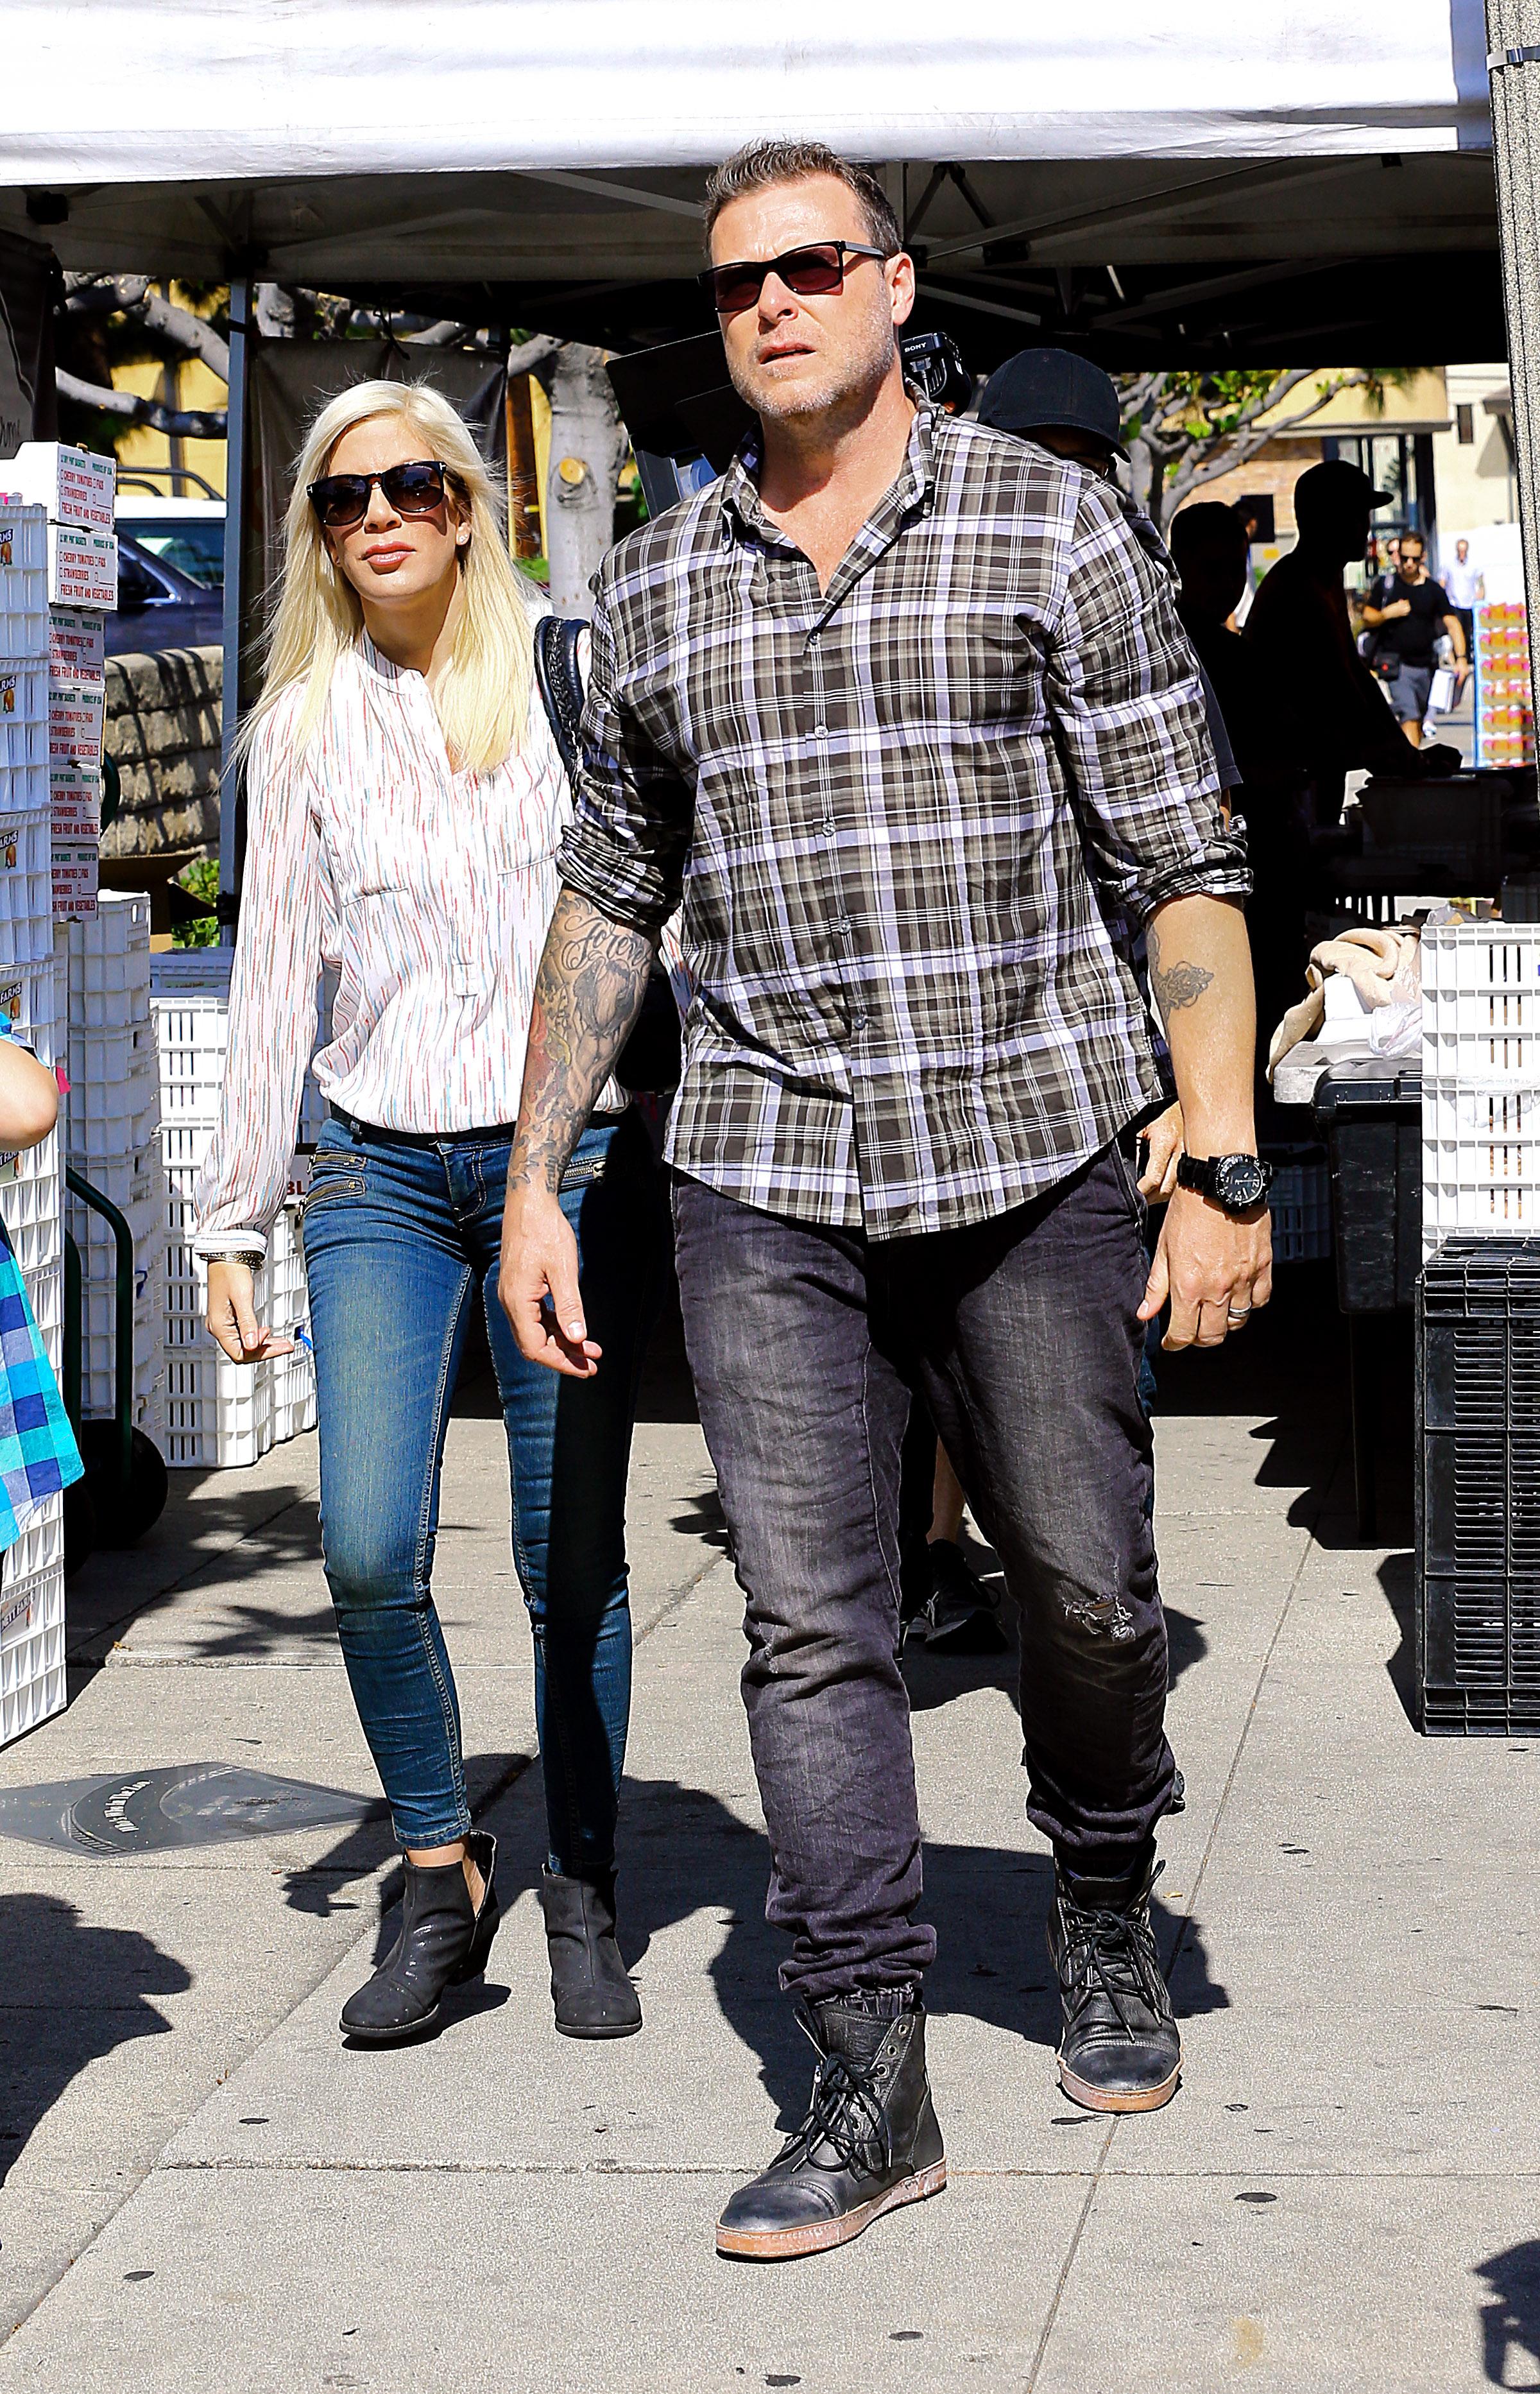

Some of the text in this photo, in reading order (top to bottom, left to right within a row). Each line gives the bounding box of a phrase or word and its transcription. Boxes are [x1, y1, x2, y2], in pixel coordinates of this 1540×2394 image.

[904, 341, 927, 353] SONY
[64, 470, 75, 483] CHERRY
[76, 474, 92, 487] TOMATOES
[64, 487, 87, 501] STRAWBERRIES
[62, 502, 72, 514] FRESH
[73, 505, 82, 517] FRUIT
[90, 510, 110, 524] VEGETABLES
[64, 552, 76, 563] CHERRY
[78, 554, 94, 566] TOMATOES
[64, 568, 89, 581] STRAWBERRIES
[61, 584, 73, 596] FRESH
[74, 585, 83, 597] FRUIT
[92, 589, 114, 601] VEGETABLES
[53, 632, 65, 644] CHERRY
[66, 634, 83, 646] TOMATOES
[52, 650, 77, 661] STRAWBERRIES
[49, 665, 60, 676] FRESH
[62, 667, 72, 678] FRUIT
[80, 668, 101, 681] VEGETABLES
[52, 710, 64, 720] CHERRY
[65, 711, 81, 721] TOMATOES
[51, 726, 75, 737] STRAWBERRIES
[60, 743, 69, 754] FRUIT
[78, 744, 98, 755] VEGETABLES
[54, 791, 65, 801] CHERRY
[67, 791, 82, 801] TOMATOES
[54, 807, 77, 816] STRAWBERRIES
[51, 823, 62, 834] FRESH
[64, 823, 73, 834] FRUIT
[81, 823, 98, 834] VEGETABLES
[62, 869, 77, 878] TOMATOES
[58, 901, 67, 911] FRUIT
[76, 900, 95, 911] VEGETABLES
[1, 983, 22, 1004] FARMS
